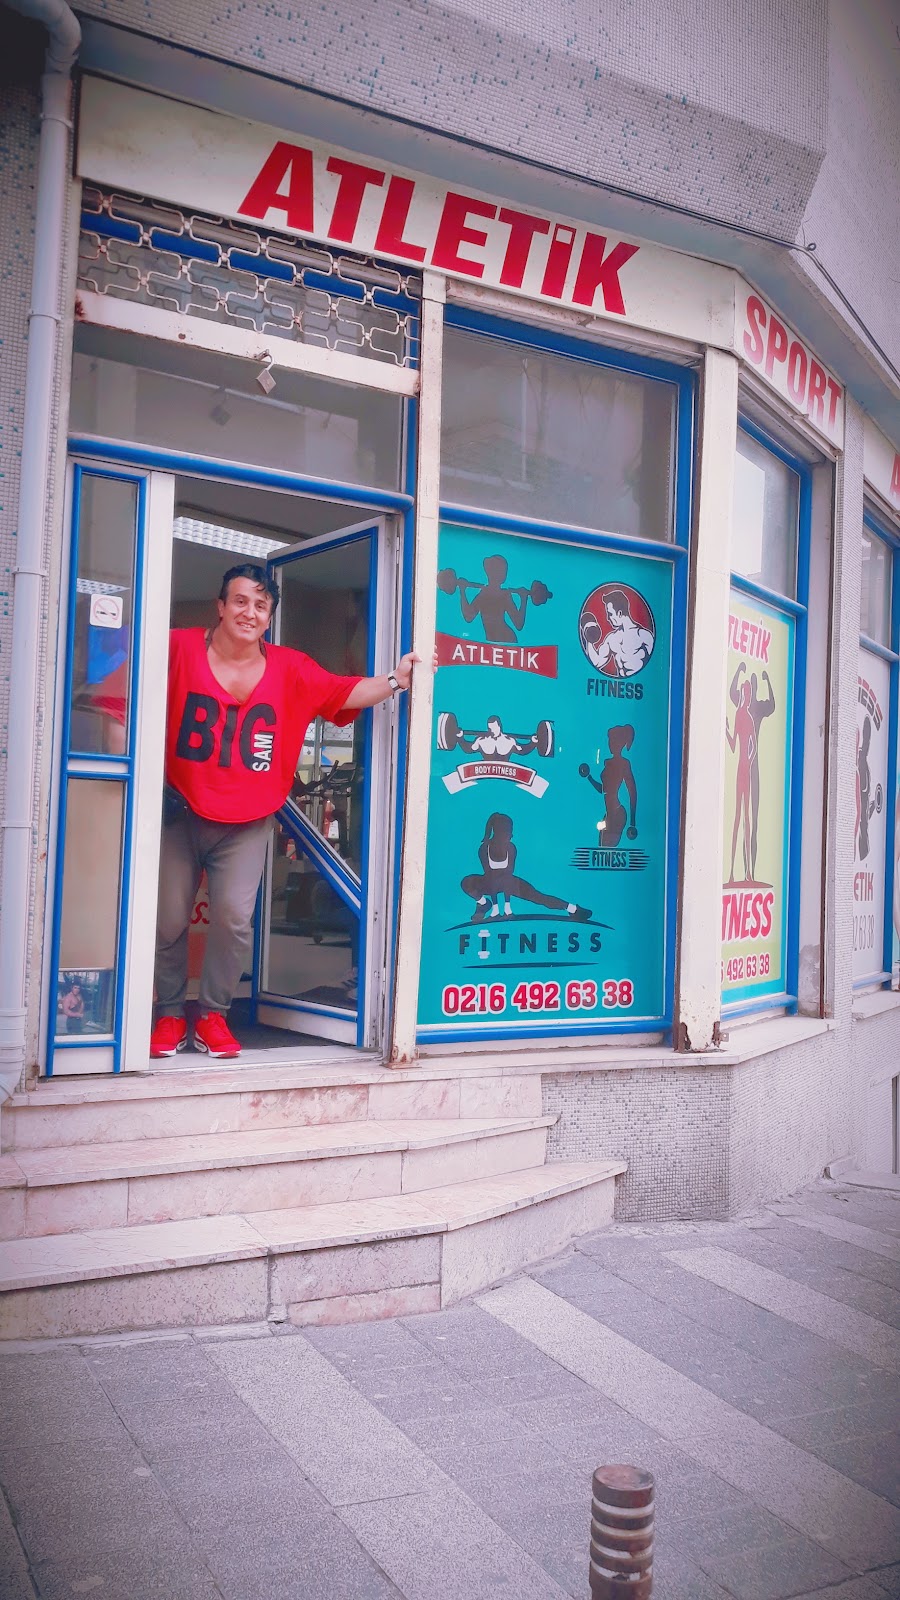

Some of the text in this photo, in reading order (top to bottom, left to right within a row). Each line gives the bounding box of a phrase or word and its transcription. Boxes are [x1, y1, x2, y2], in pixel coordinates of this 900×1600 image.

[743, 295, 842, 434] SPORT
[452, 643, 540, 670] ATLETİK
[587, 678, 644, 700] FITNESS
[175, 690, 277, 772] BIG
[252, 733, 274, 772] SAM
[474, 765, 517, 777] BODY FITNESS
[591, 850, 627, 869] FITNESS
[459, 930, 602, 959] FITNESS
[727, 957, 744, 981] 492
[746, 955, 757, 978] 63
[759, 953, 770, 976] 38
[443, 979, 634, 1015] 0216 492 63 38
